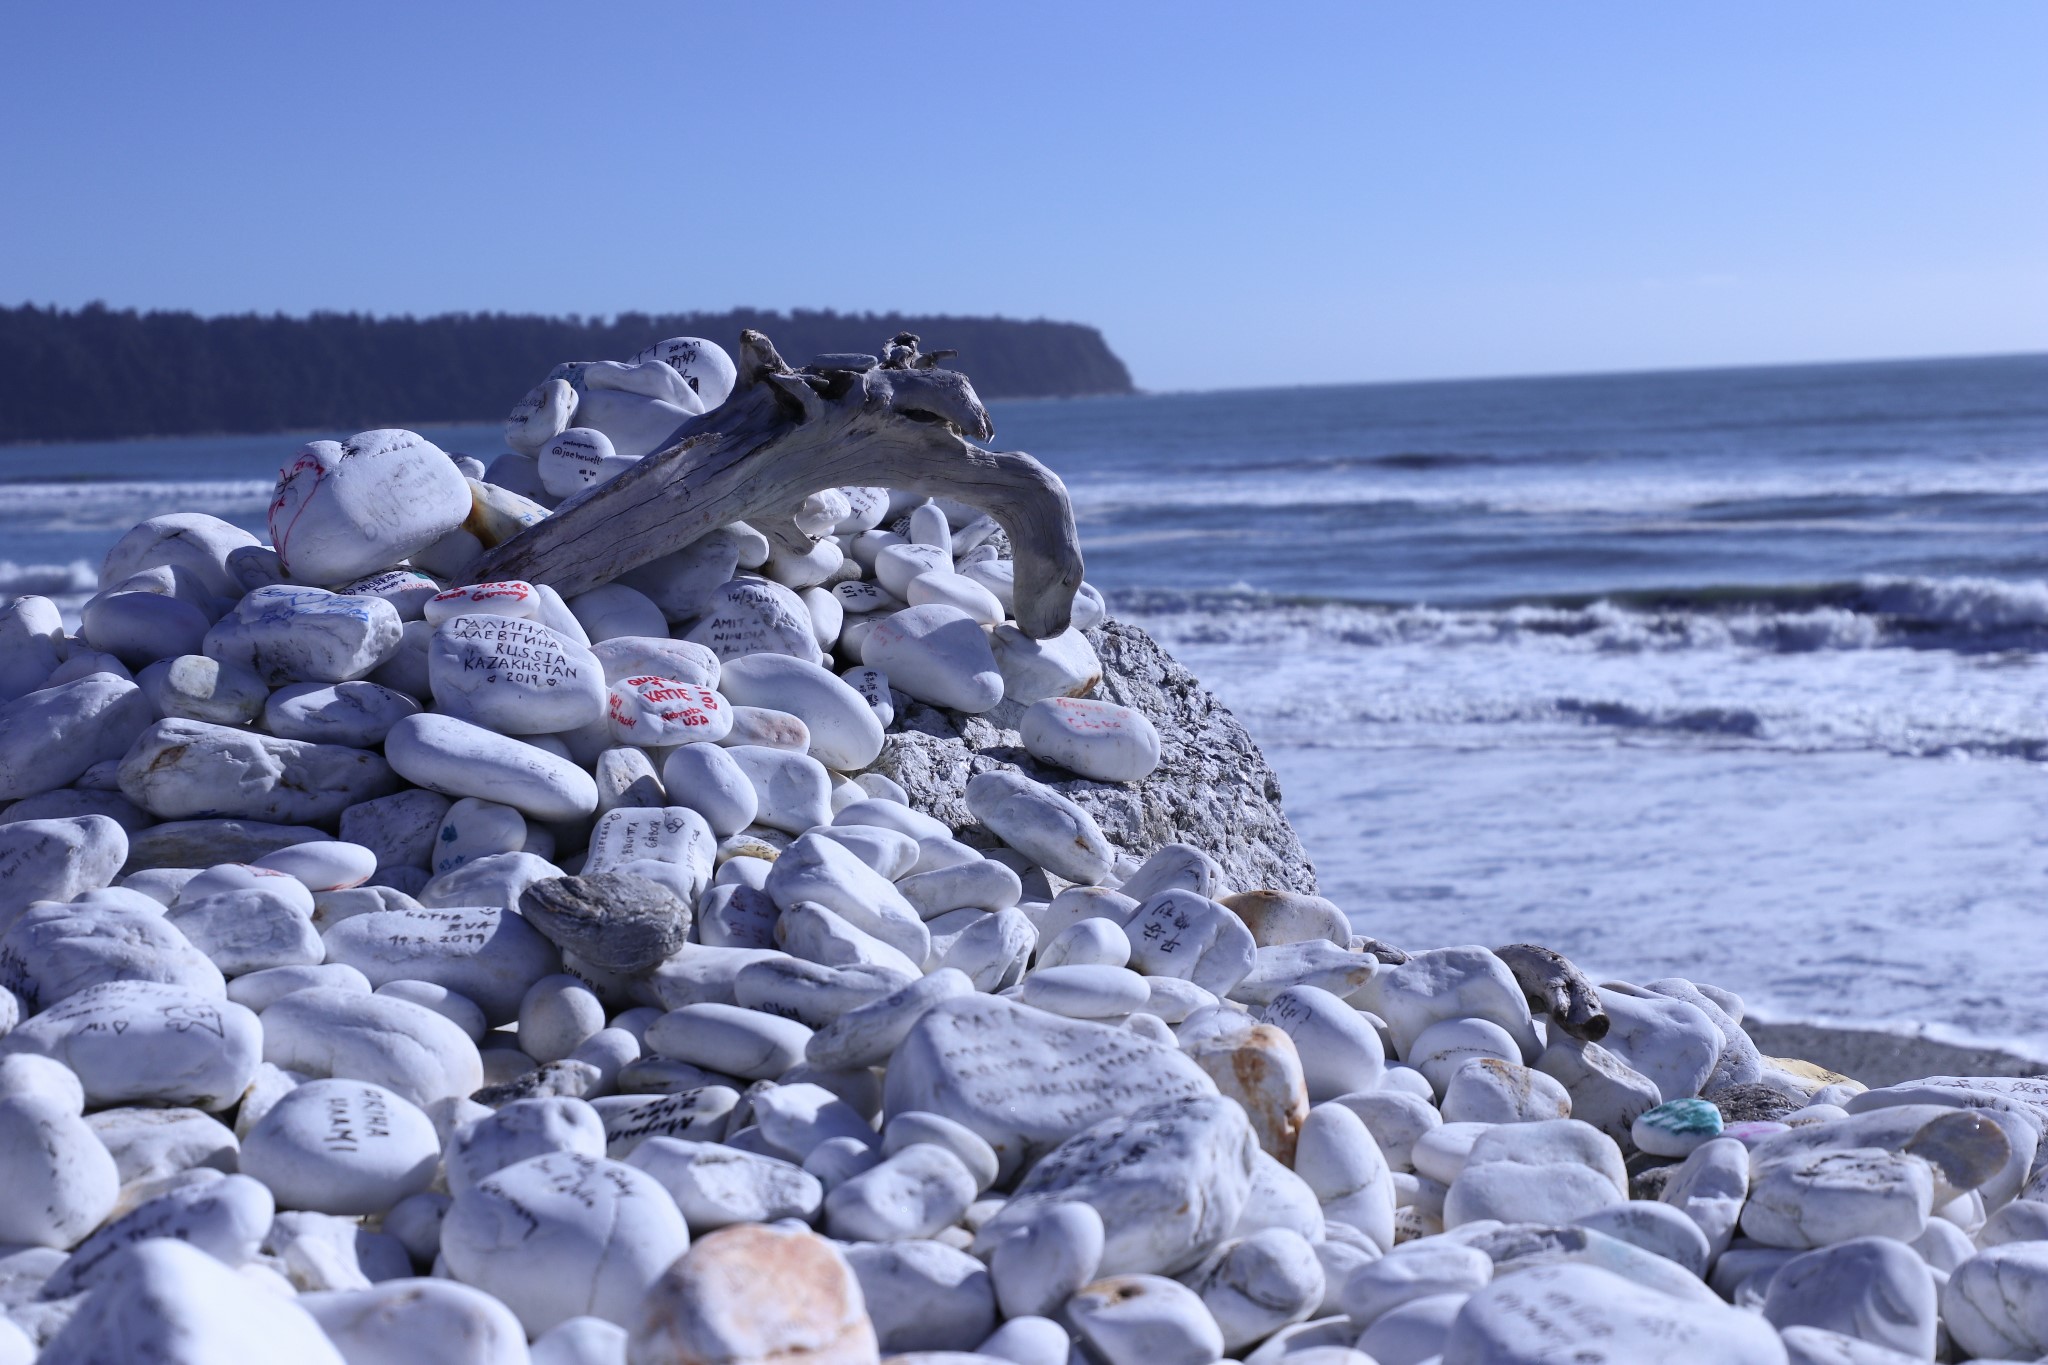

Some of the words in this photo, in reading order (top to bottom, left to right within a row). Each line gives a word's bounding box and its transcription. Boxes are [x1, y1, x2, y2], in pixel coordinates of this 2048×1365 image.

[471, 590, 529, 602] Germany
[454, 618, 549, 638] ГАЛИНА
[711, 617, 744, 630] AMIT
[455, 630, 559, 650] АЛЕВТИНА
[496, 643, 566, 666] RUSSIA
[464, 656, 577, 679] KAZAKHSTAN
[507, 672, 538, 685] 2019
[643, 688, 693, 703] KATIE
[682, 715, 709, 727] USA
